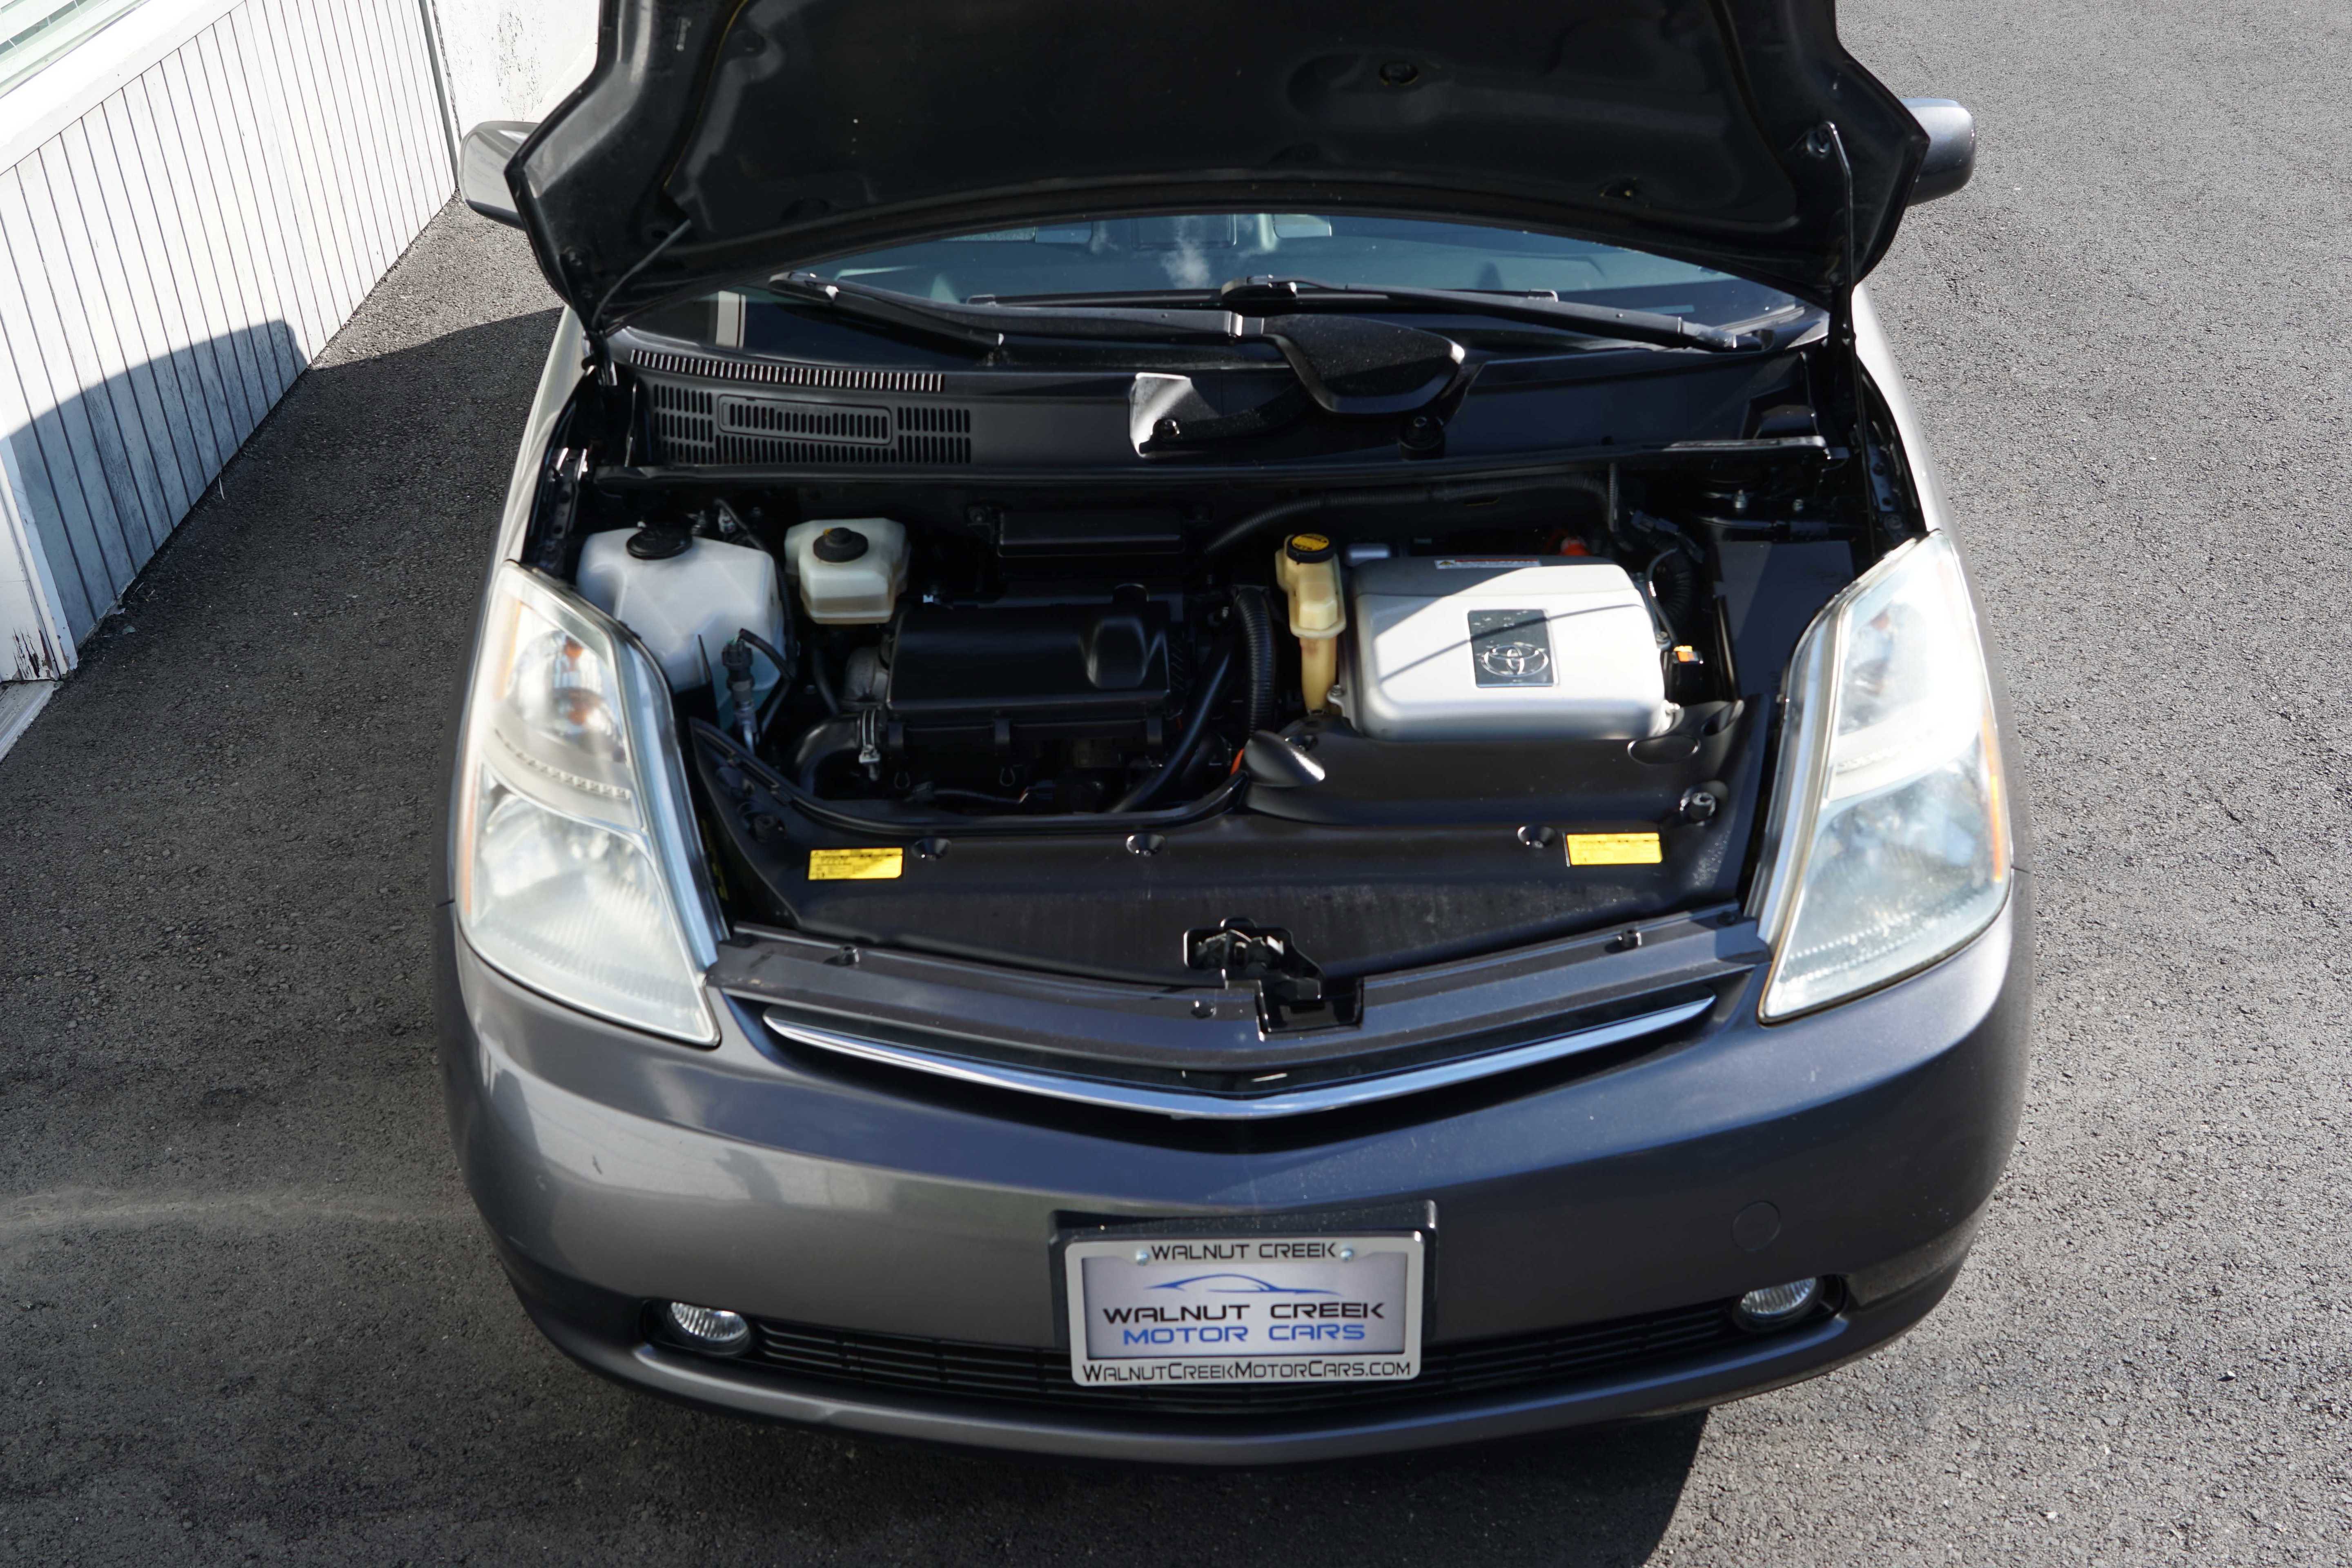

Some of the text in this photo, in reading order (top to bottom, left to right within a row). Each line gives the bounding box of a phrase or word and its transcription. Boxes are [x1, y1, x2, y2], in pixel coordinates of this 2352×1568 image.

[1152, 1242, 1336, 1261] WALNUT CREEK
[1103, 1302, 1384, 1323] WALNUT CREEK
[1123, 1324, 1365, 1345] MOTOR CARS
